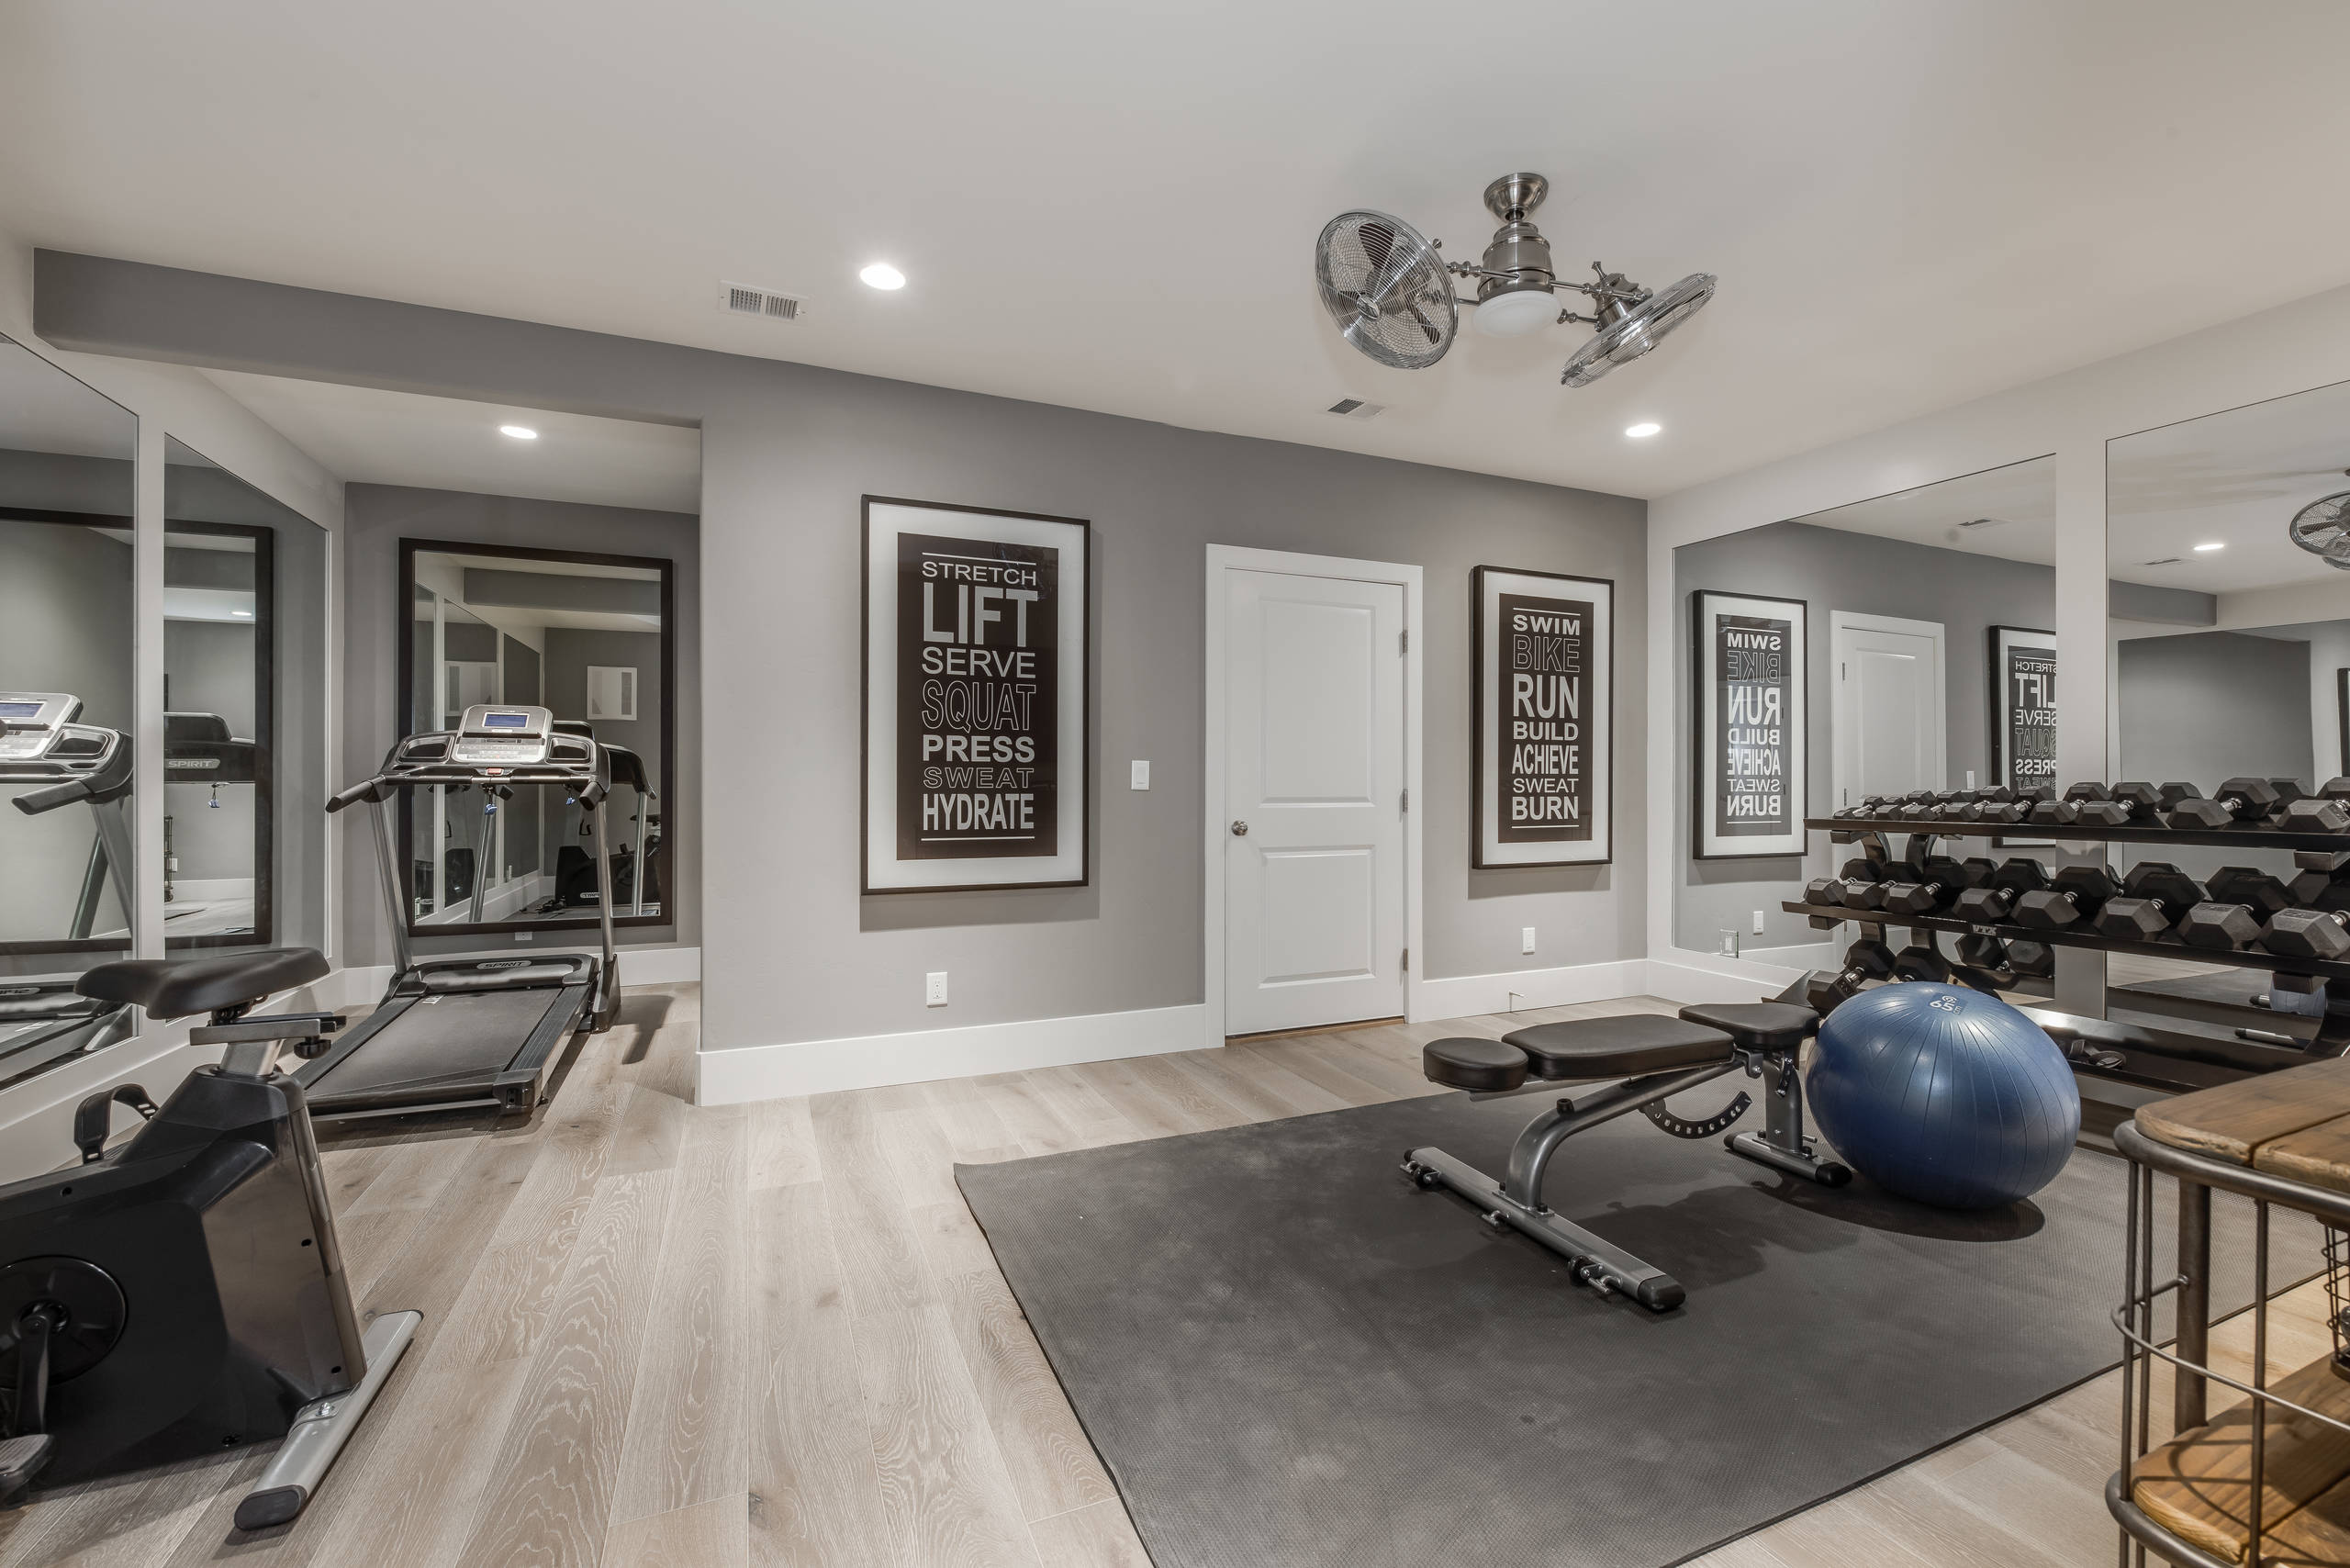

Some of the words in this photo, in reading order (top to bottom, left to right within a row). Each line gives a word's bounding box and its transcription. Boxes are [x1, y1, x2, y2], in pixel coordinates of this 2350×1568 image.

[923, 561, 1035, 586] STRETCH
[923, 582, 1038, 647] LIFT
[1513, 614, 1580, 635] SWIM
[922, 646, 1035, 678] SERVE
[1513, 633, 1580, 672] BIKE
[922, 679, 1036, 734] SQUAT
[1513, 674, 1579, 719] RUN
[1513, 721, 1579, 742] BUILD
[923, 734, 1035, 762] PRESS
[1512, 745, 1579, 775] ACHIEVE
[923, 767, 1034, 789] SWEAT
[1513, 778, 1579, 793] SWEAT
[923, 793, 1035, 831] HYDRATE
[1512, 796, 1579, 820] BURN
[1930, 1000, 1954, 1012] 65
